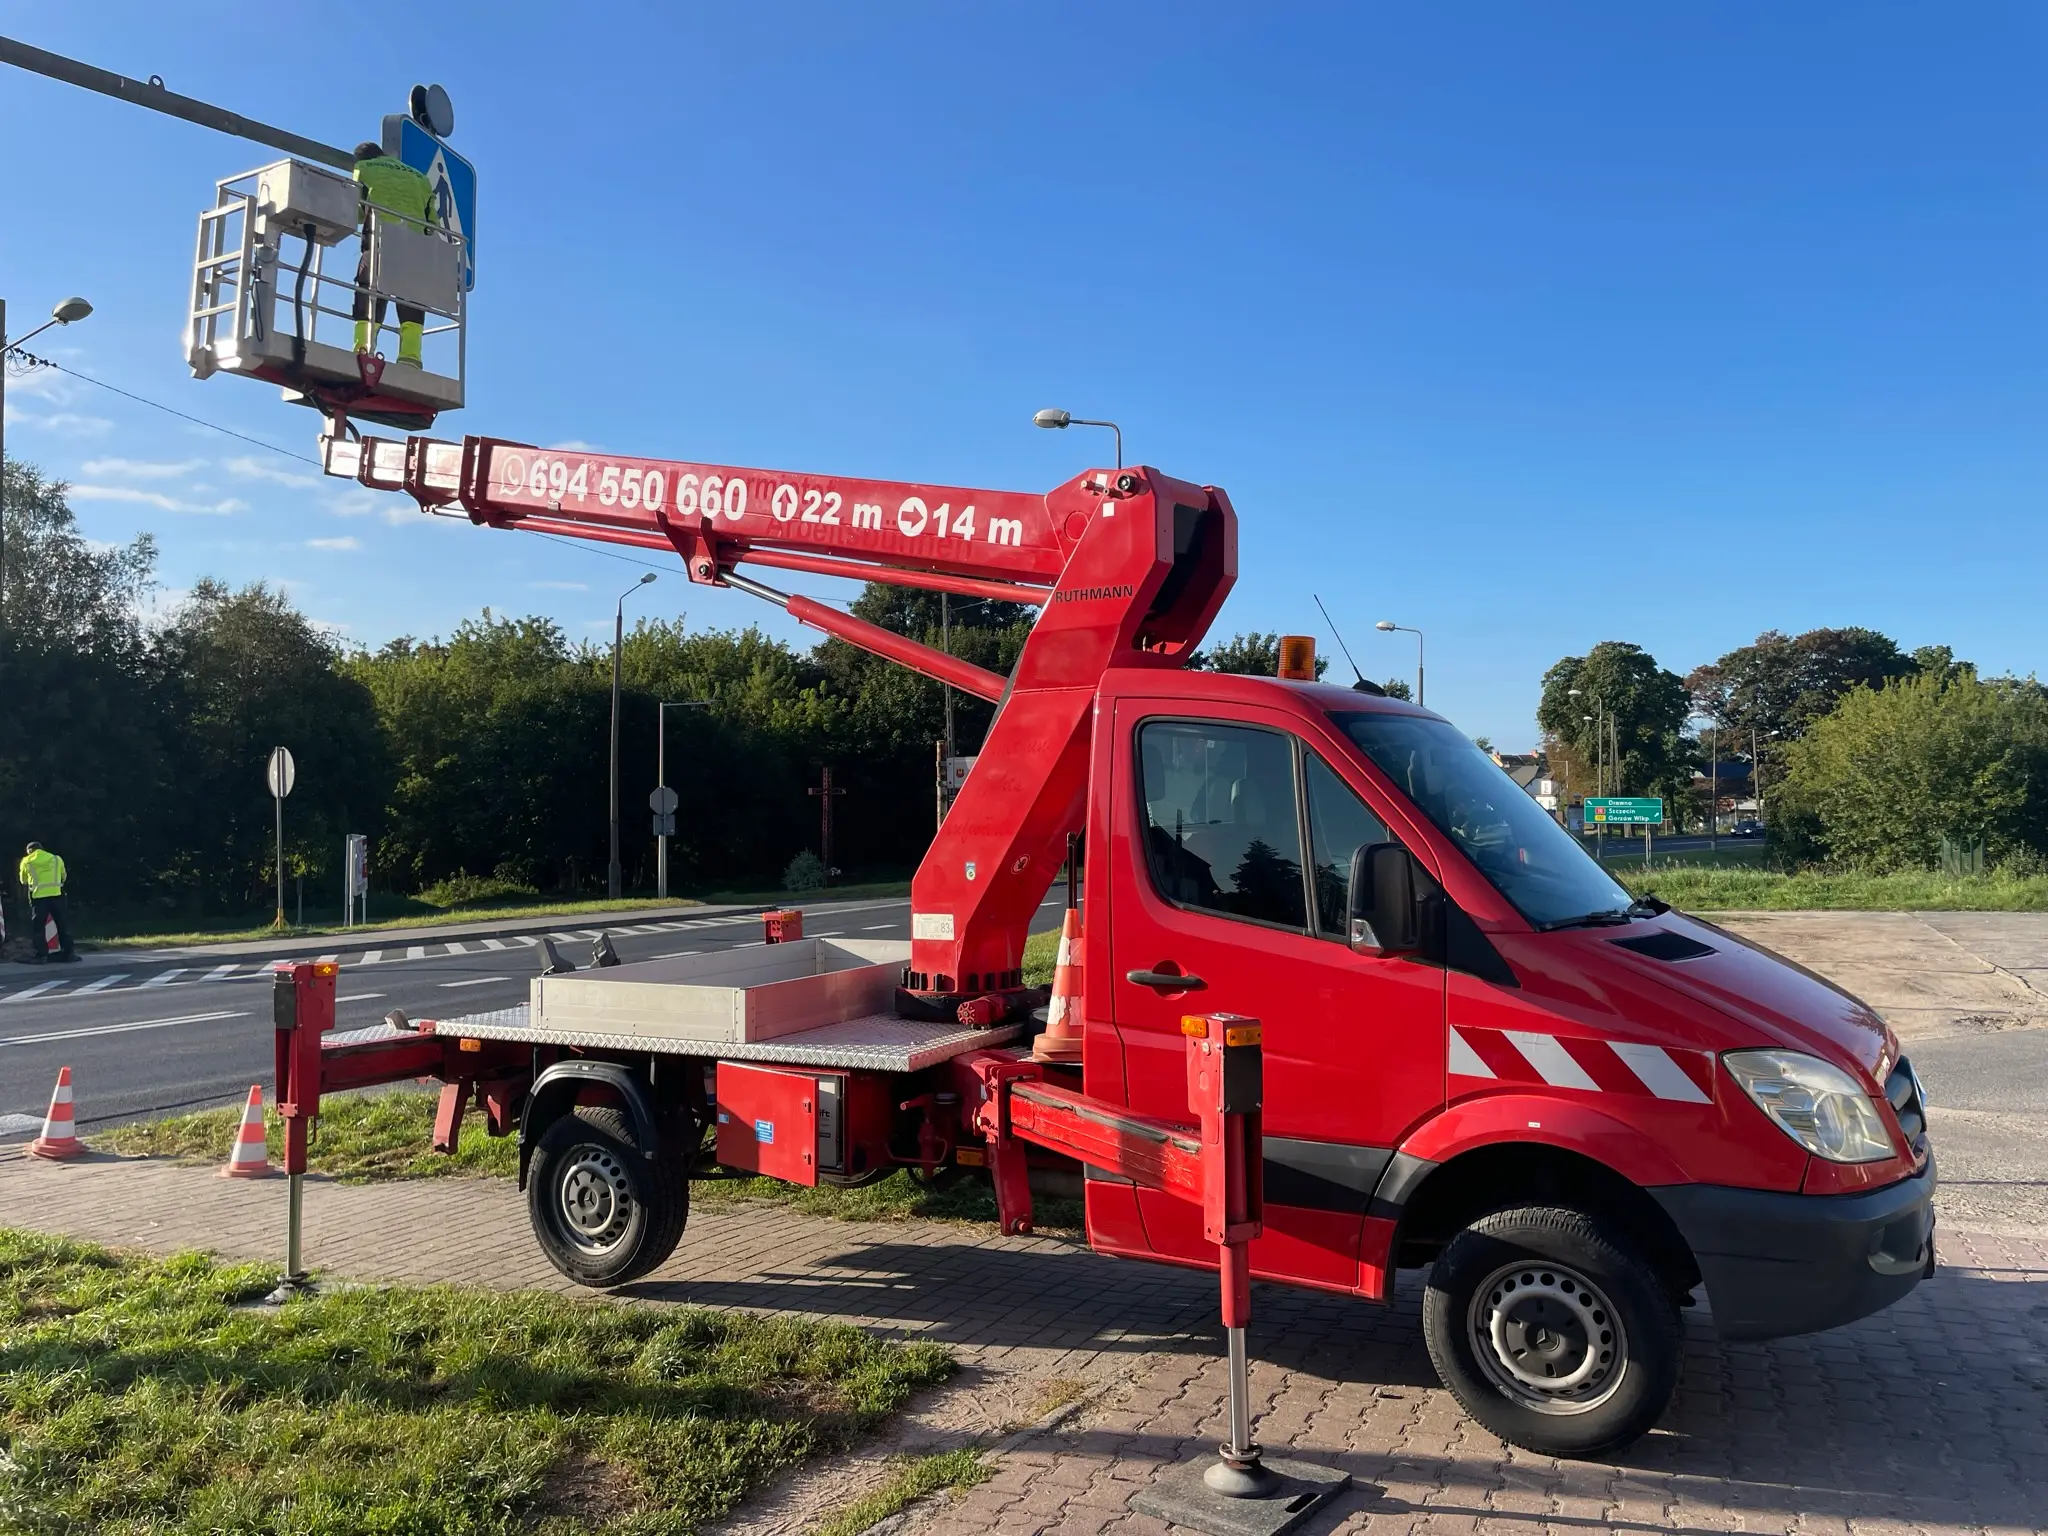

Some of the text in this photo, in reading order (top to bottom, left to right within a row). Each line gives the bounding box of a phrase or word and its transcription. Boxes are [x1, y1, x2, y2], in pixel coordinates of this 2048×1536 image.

[529, 459, 588, 502] 694
[599, 466, 664, 511] 550
[676, 473, 748, 521] 660
[801, 489, 883, 530] 22 m
[932, 502, 1023, 547] 14 m
[1055, 585, 1133, 603] RUTHMANN
[818, 1109, 830, 1117] ift
